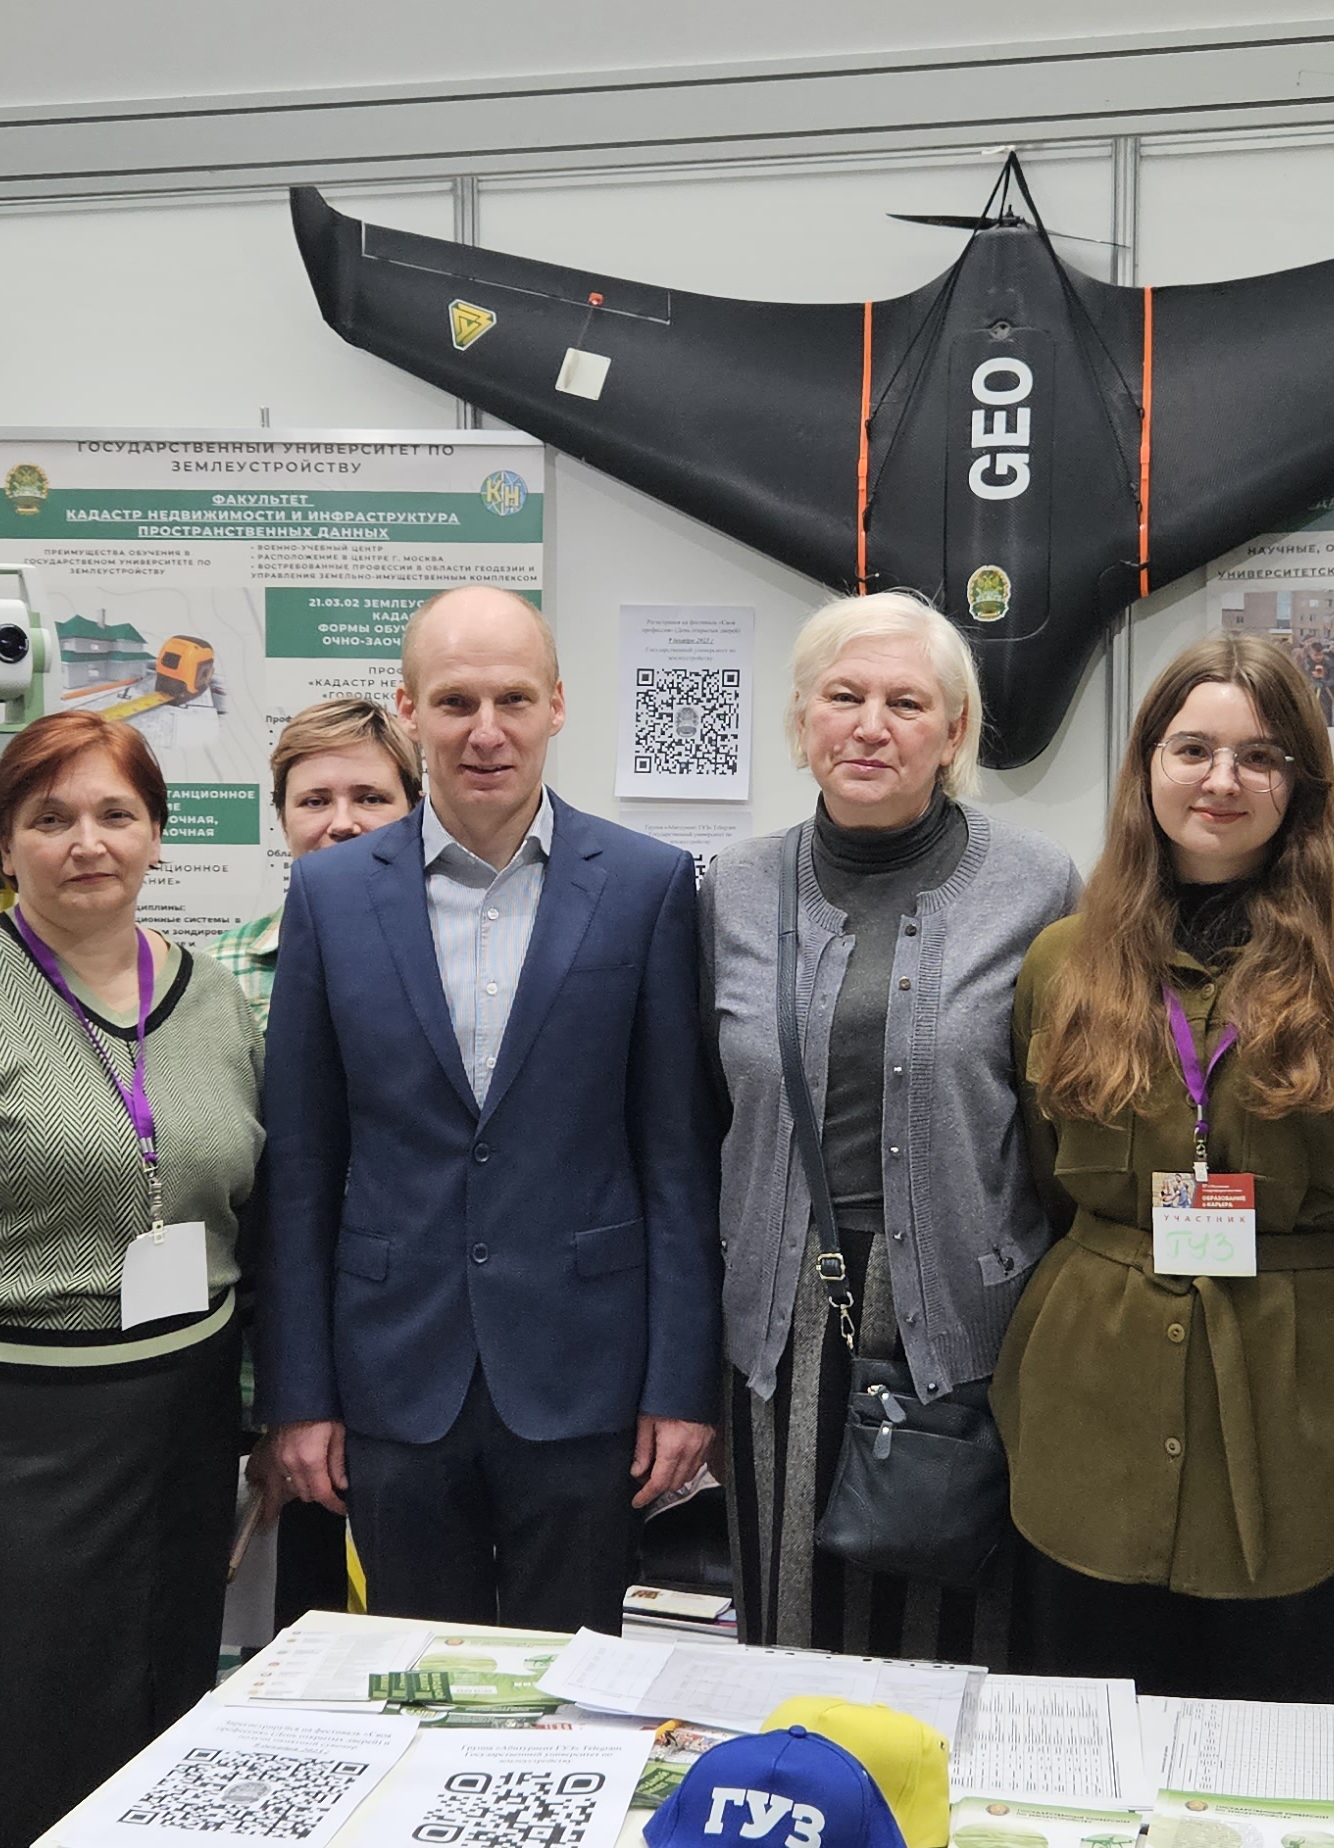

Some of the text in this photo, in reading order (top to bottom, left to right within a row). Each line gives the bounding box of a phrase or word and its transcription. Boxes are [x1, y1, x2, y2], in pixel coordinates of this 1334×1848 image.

[968, 356, 1034, 500] GEO
[283, 443, 419, 456] УНИВЕРСИТЕТ
[428, 444, 454, 456] ПО
[171, 458, 362, 474] ЗЕМЛЕУСТРОЙСТВУ
[212, 493, 309, 506] ФАКУЛЬТЕТ
[66, 509, 460, 525] КАДАСТР НЕДВИЖИМОСТИ И ИНФРАСТРУКТУРА
[138, 525, 390, 540] ПРОСТРАНСТВЕННЫХ ДАННЫХ
[44, 549, 126, 557] ПРЕИМУЩЕСТВА
[128, 549, 182, 557] ОБУЧЕНИЯ
[257, 543, 384, 553] ВОЕННО-УЧЕБНЫЙ ЦЕНТР
[119, 558, 194, 566] УНИВЕРСИТЕТЕ
[258, 554, 339, 562] РАСПОЛОЖЕНИЕ
[351, 555, 389, 563] ЦЕНТРЕ
[403, 555, 444, 563] МОСКВА
[69, 567, 165, 576] ЗЕМЛЕУСТРОЙСТВУ
[258, 563, 350, 571] ВОСТРЕБОВАННЫЕ
[475, 565, 526, 573] ГЕОДЕЗИИ
[251, 572, 538, 583] УПРАВЛЕНИЯ ЗЕМЕЛЬНО-ИМУЩЕСТВЕННЫМ КОМПЛЕКСОМ
[308, 598, 360, 608] 21.03.02
[317, 623, 370, 634] ФОРМЫ
[322, 636, 401, 647] ОЧНО-ЗАОЧ
[308, 678, 375, 688] «КАДАСТР
[1163, 1213, 1246, 1224] УЧАСТНИК
[703, 1786, 826, 1848] ГУЗ
